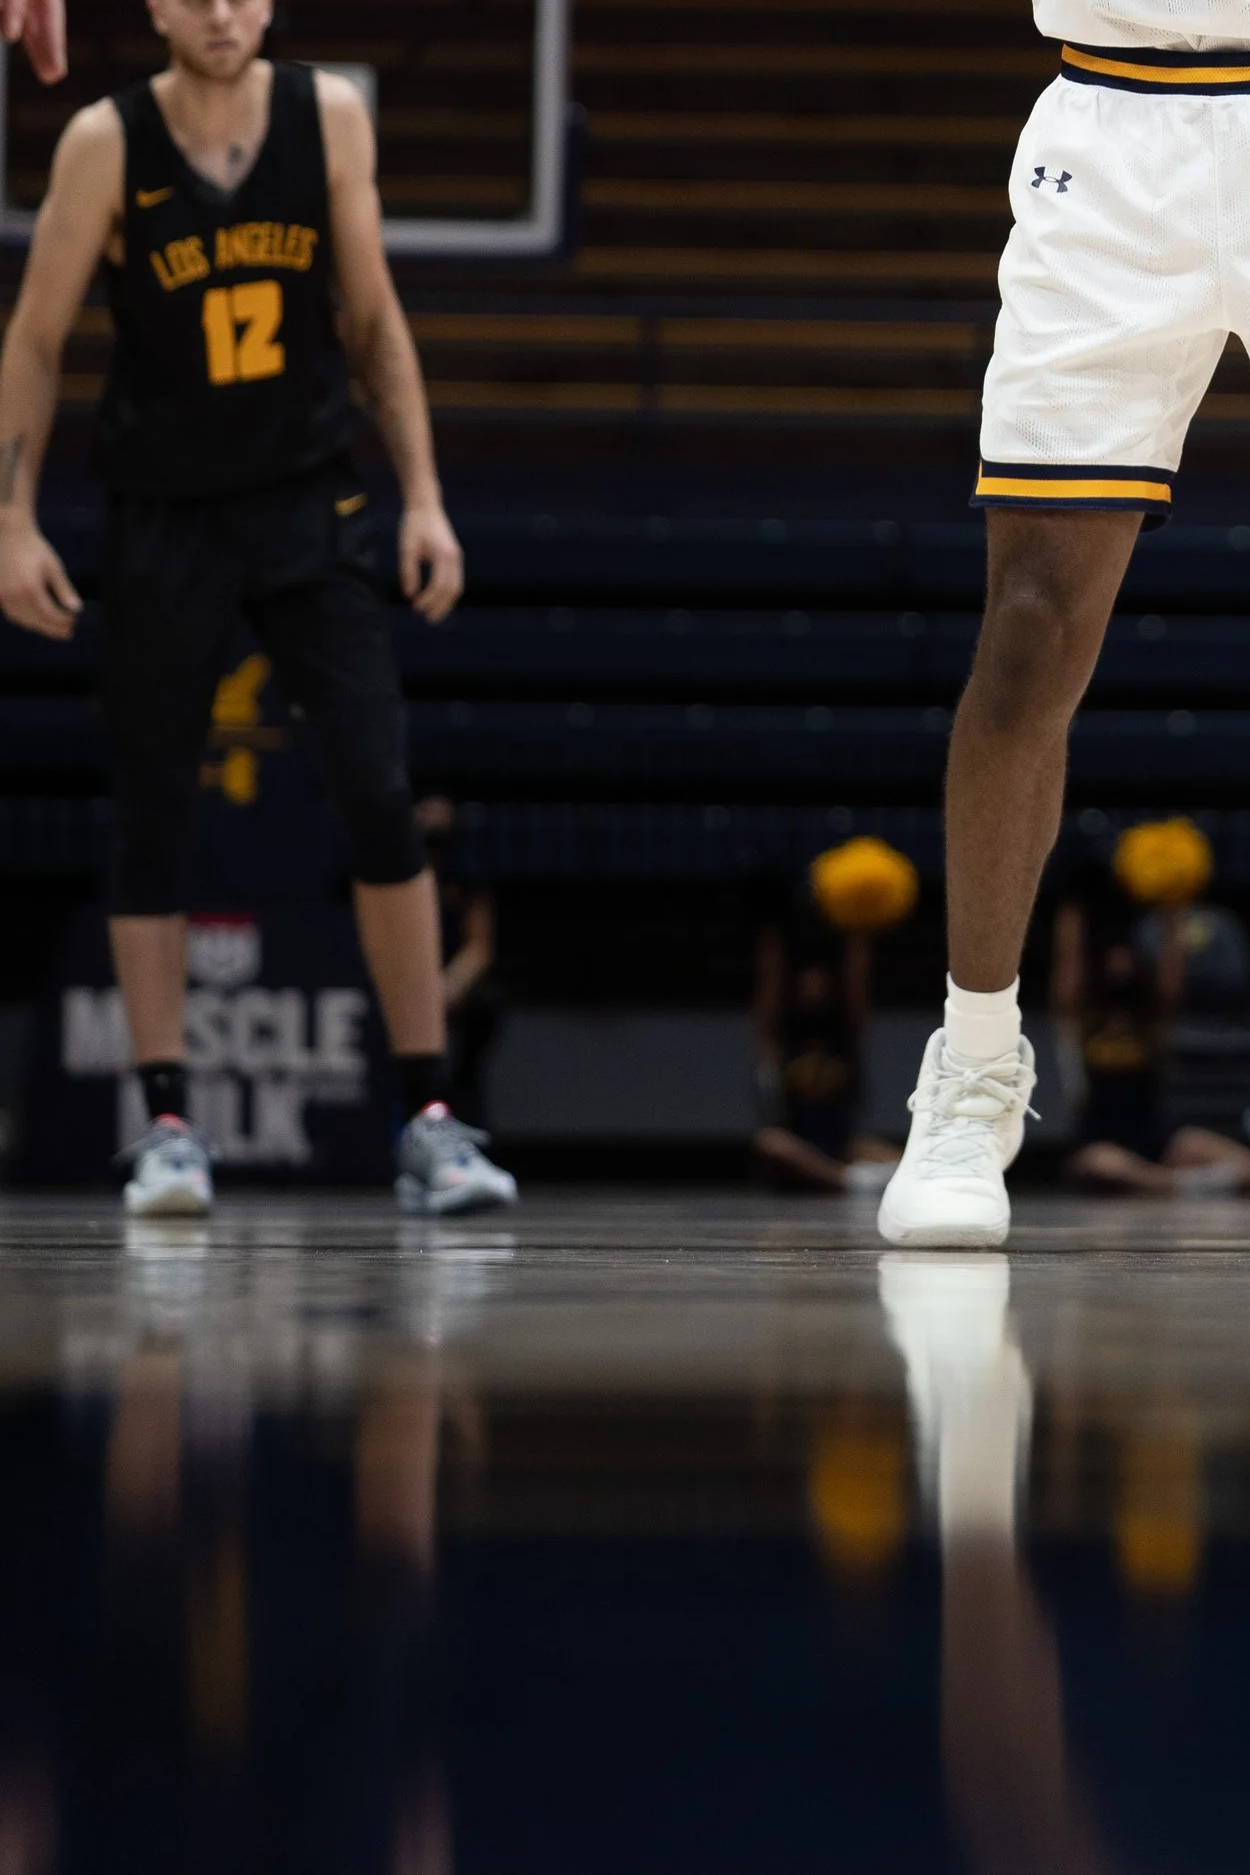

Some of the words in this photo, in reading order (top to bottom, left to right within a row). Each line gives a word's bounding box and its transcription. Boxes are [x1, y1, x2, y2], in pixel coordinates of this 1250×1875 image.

[150, 236, 210, 292] LOS
[214, 221, 319, 271] ANGELES
[203, 279, 285, 386] 12
[61, 986, 369, 1075] MSCLE
